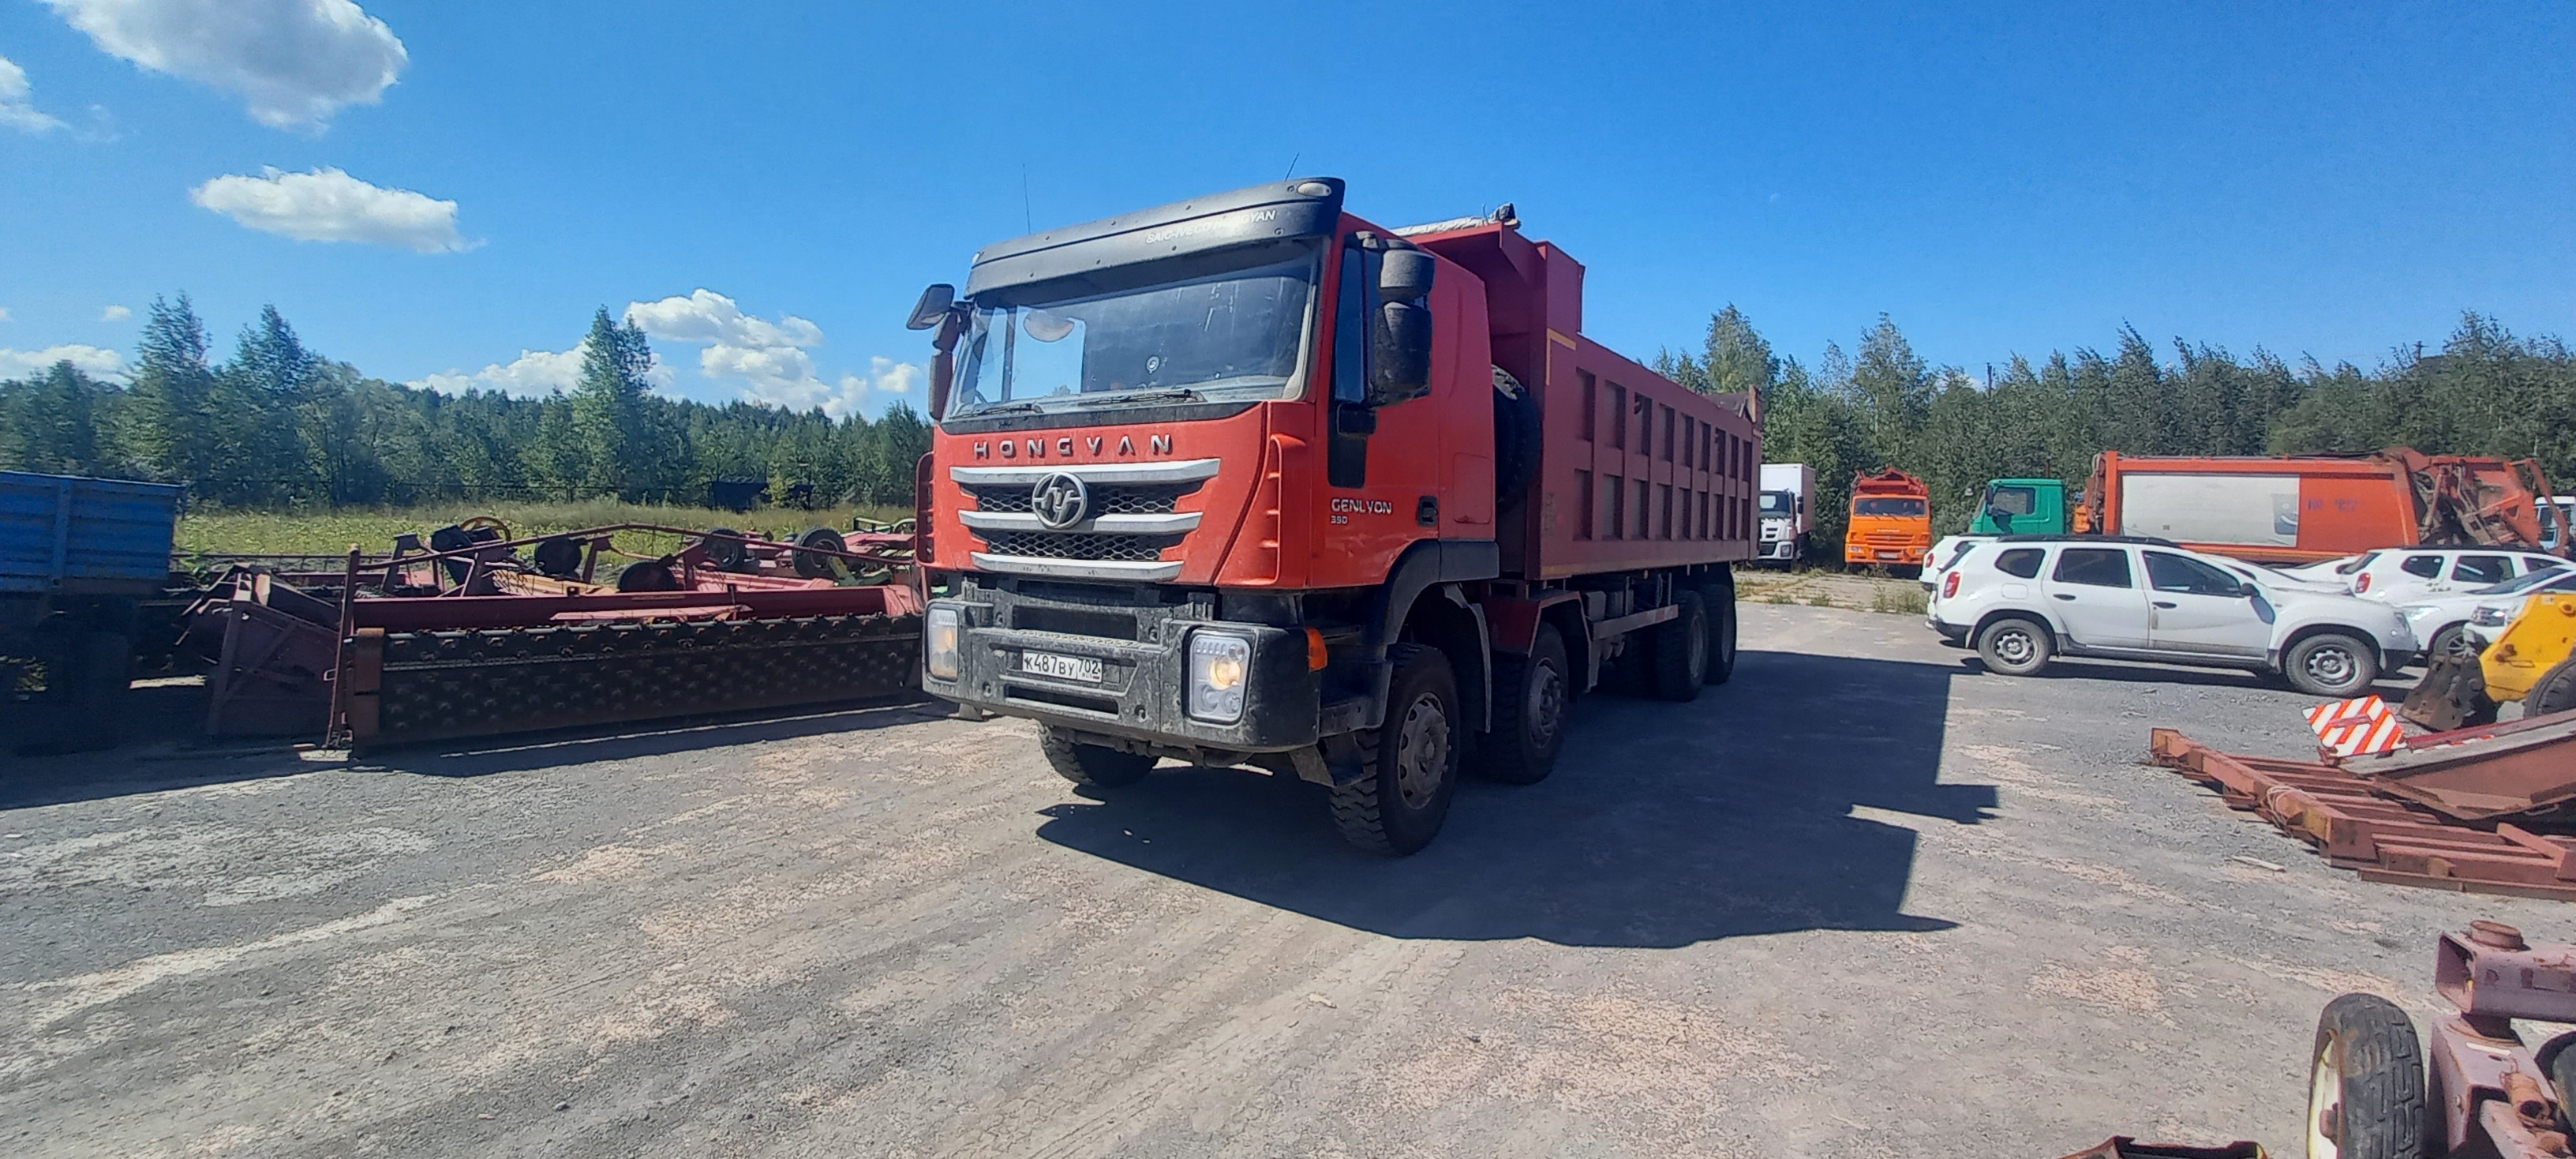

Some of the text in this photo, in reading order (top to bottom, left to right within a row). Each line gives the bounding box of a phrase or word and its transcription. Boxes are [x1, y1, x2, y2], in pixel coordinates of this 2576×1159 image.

[1146, 222, 1211, 243] SAIC-IVECO
[974, 434, 1171, 458] HONGYAN
[1331, 498, 1392, 514] GENLYON
[1331, 515, 1348, 524] 390
